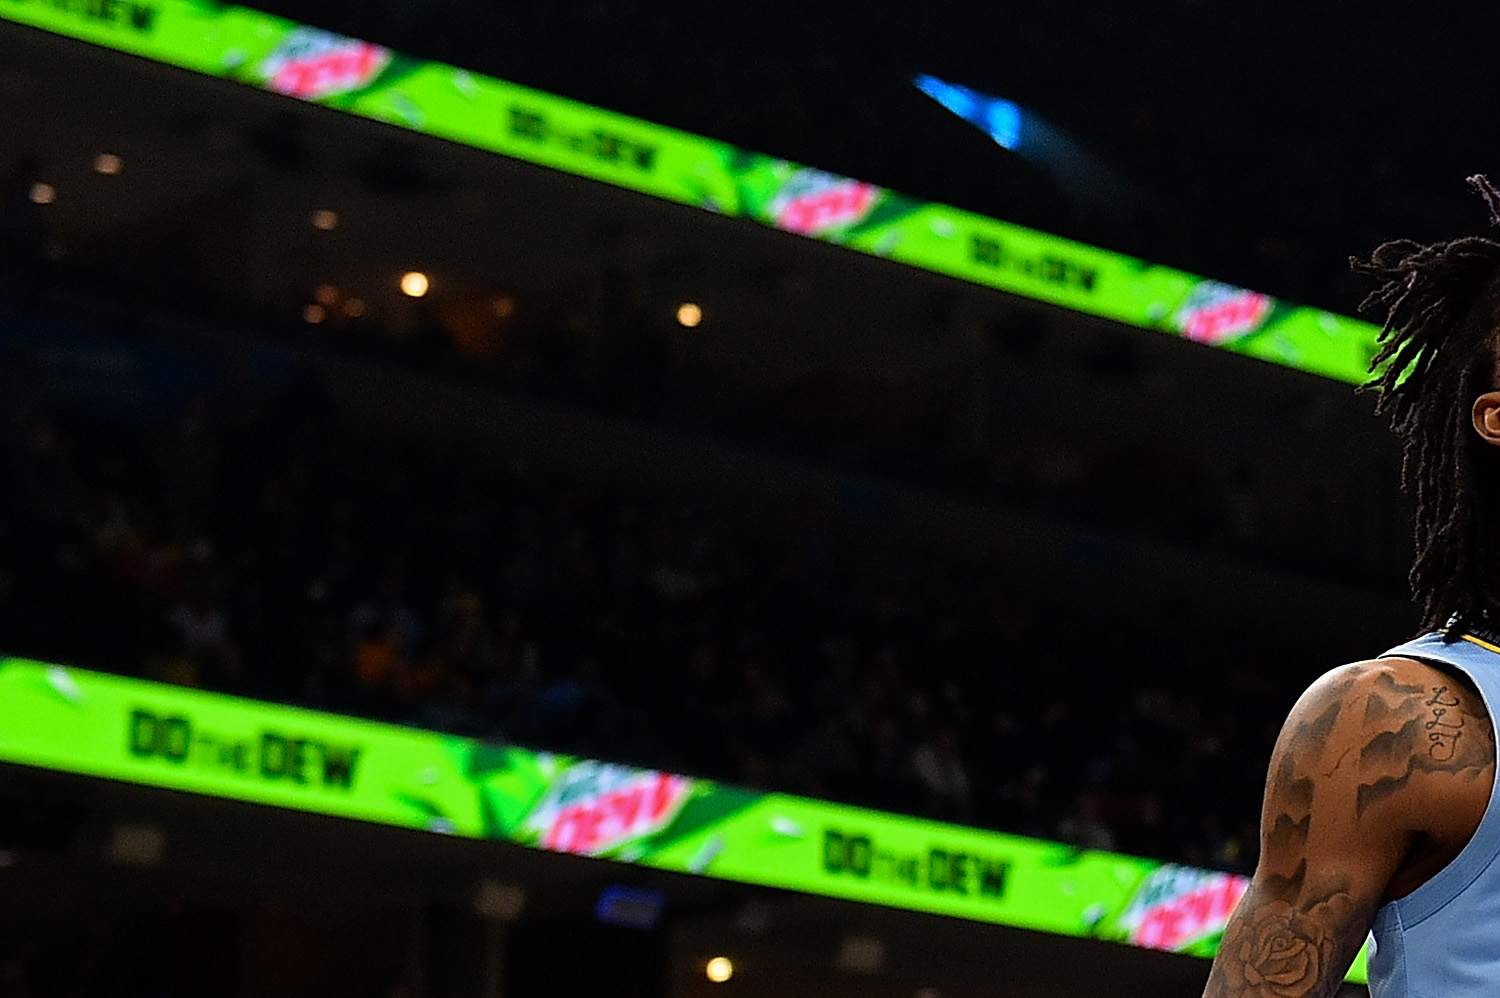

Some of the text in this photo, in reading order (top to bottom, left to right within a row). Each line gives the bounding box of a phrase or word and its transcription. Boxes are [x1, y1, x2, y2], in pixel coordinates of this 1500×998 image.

[129, 708, 194, 765] DO
[257, 730, 364, 791] DEW
[822, 829, 874, 881] DO
[928, 848, 1012, 902] DEW
